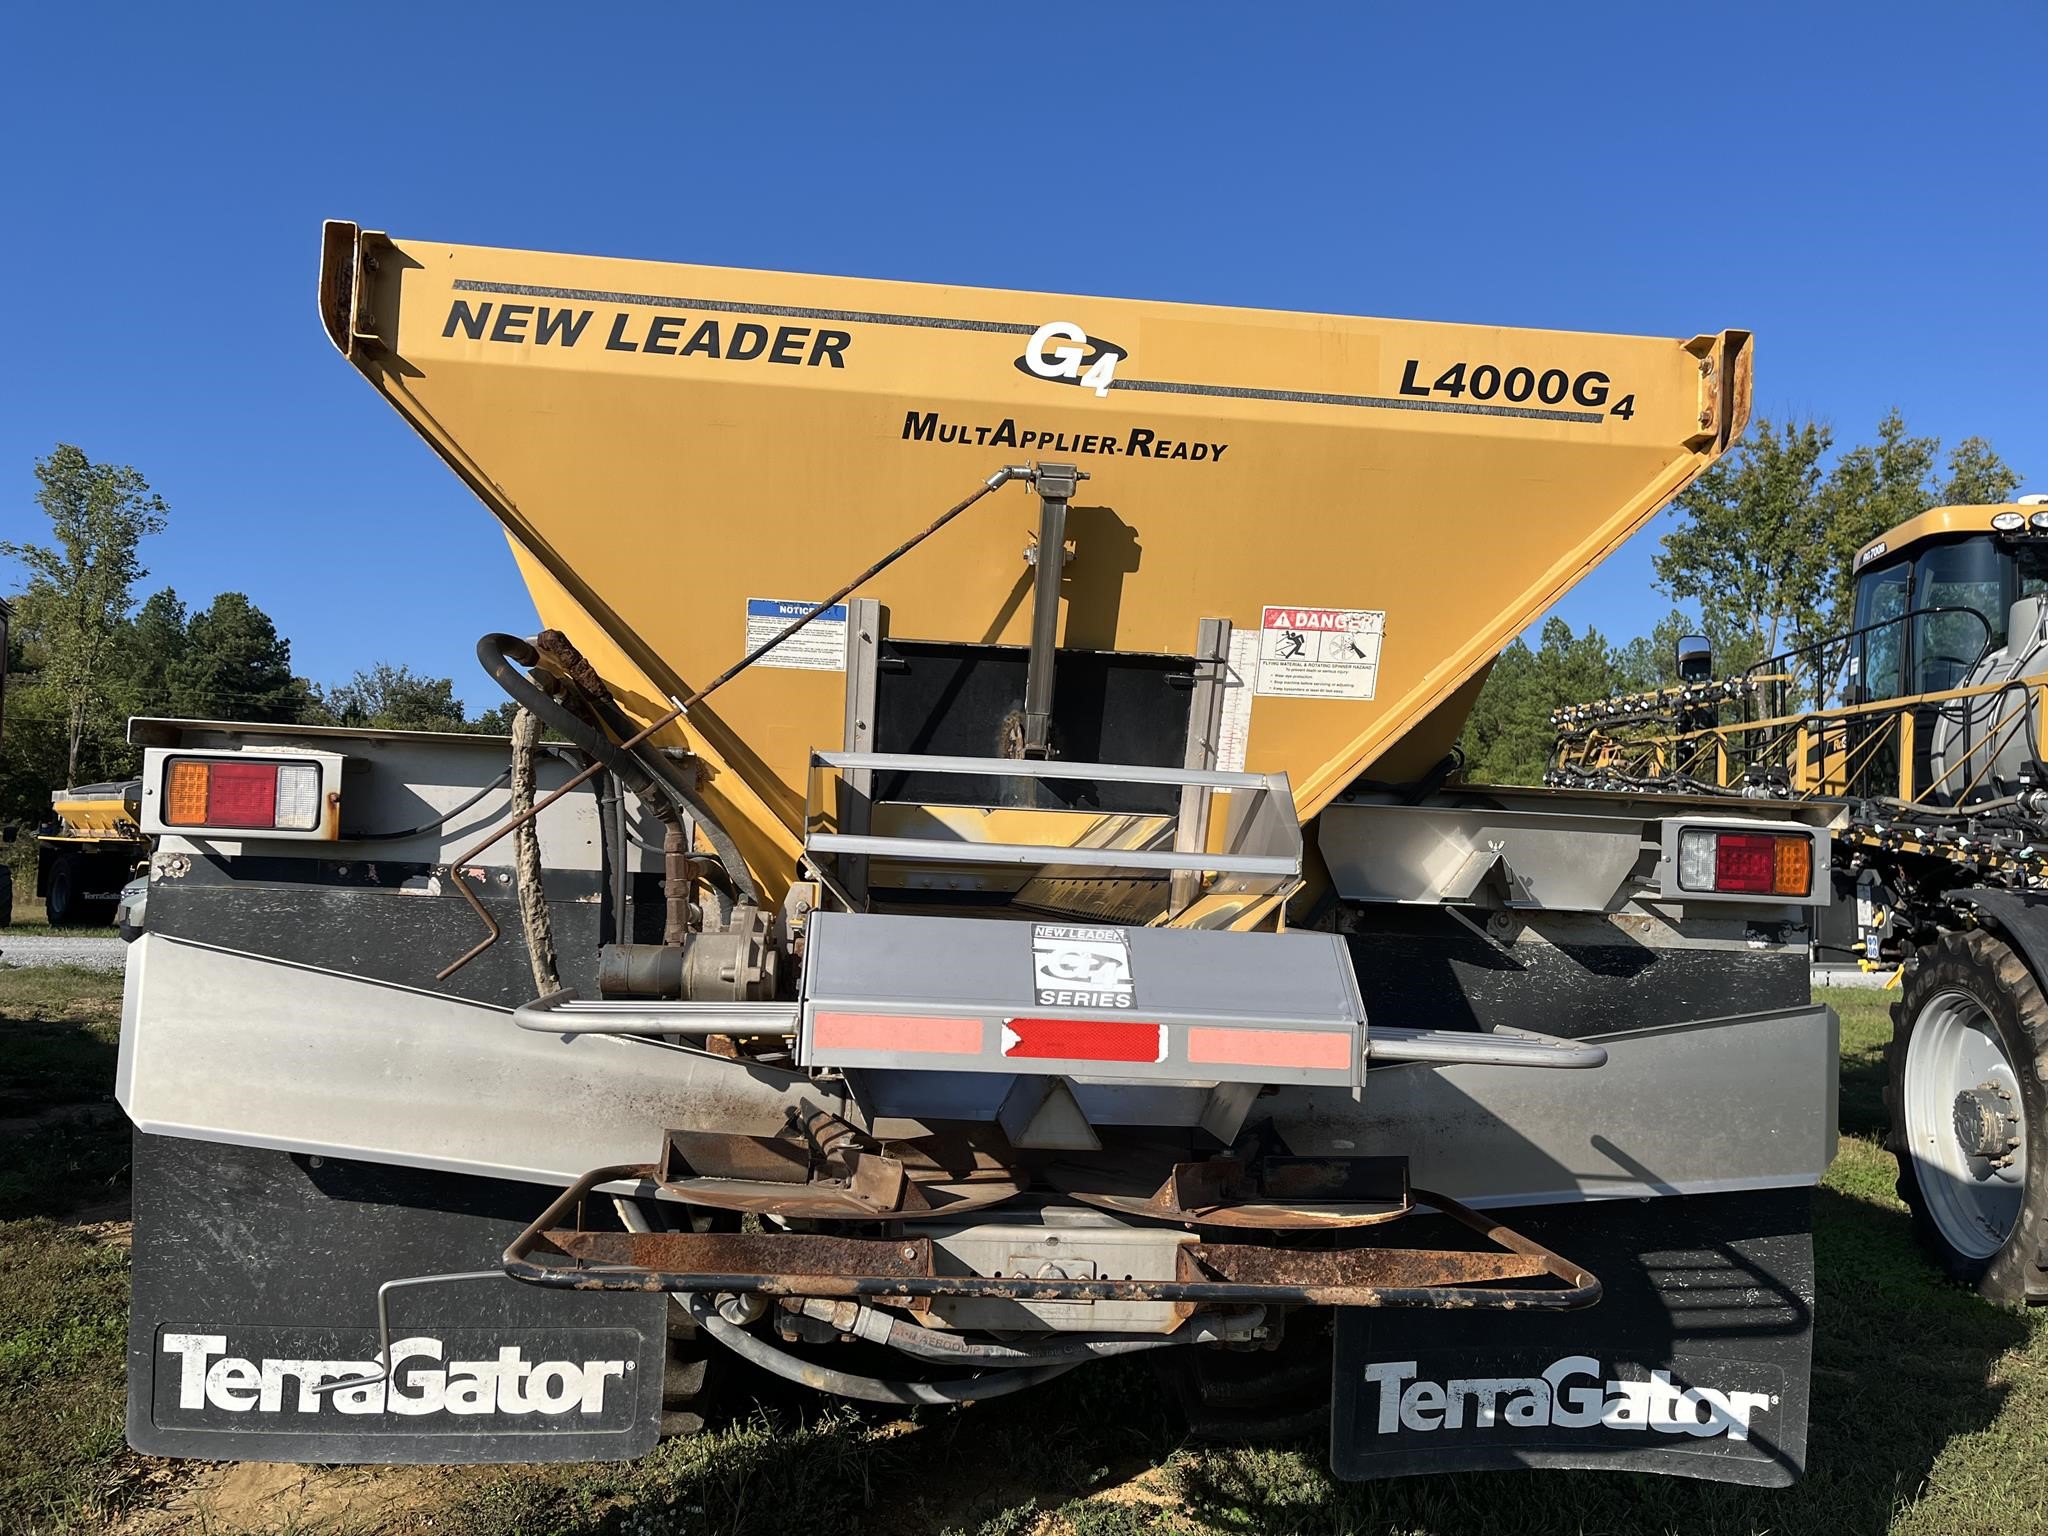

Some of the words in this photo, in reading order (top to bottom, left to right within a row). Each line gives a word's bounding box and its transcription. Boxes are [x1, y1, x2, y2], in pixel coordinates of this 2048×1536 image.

[442, 300, 595, 347] NEW
[605, 313, 852, 369] LEADER
[1399, 359, 1636, 421] L4000G4
[1295, 612, 1373, 632] DANGER
[1034, 926, 1066, 937] NEW
[1039, 990, 1131, 1008] SERIES
